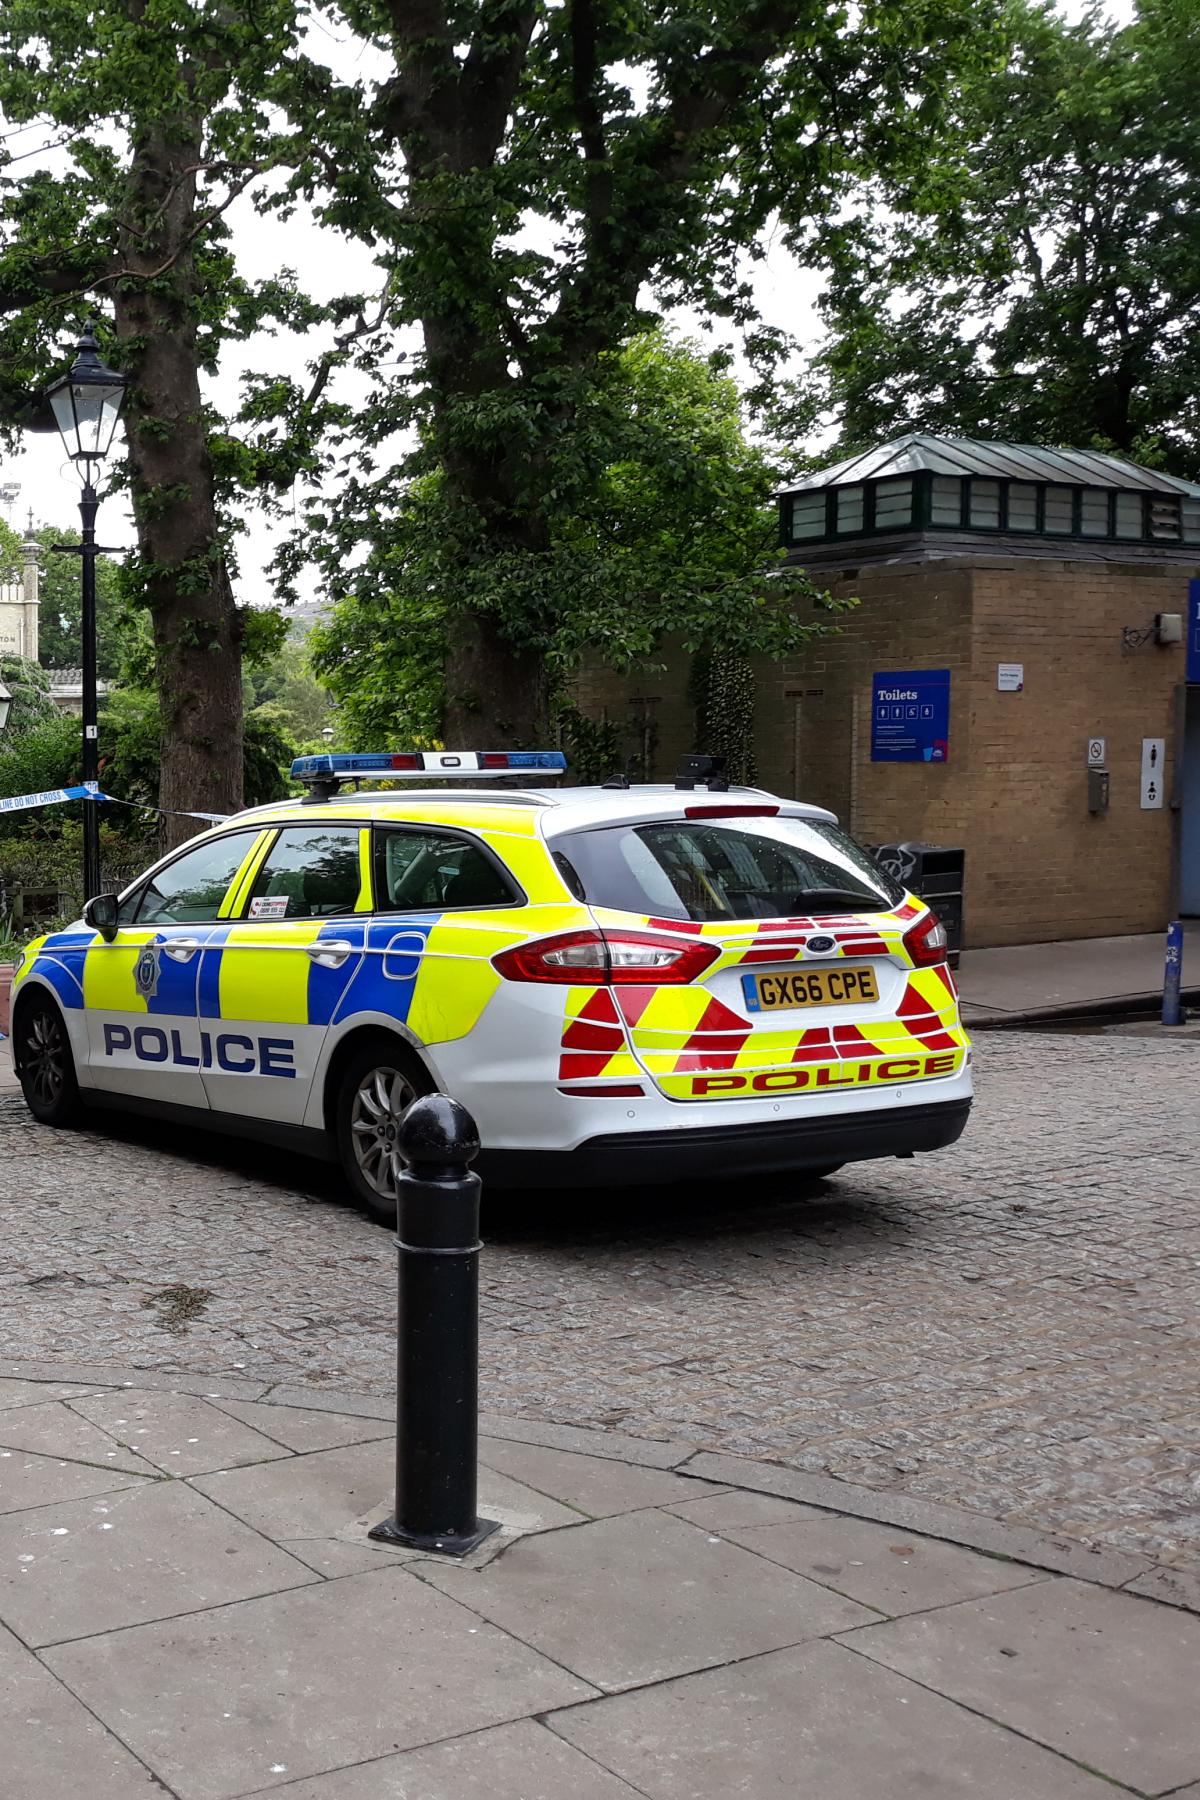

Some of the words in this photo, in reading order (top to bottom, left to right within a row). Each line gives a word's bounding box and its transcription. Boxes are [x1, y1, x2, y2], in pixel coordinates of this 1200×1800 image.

[877, 689, 918, 701] Toilets
[90, 727, 95, 737] 1
[0, 798, 14, 811] LINE
[14, 797, 25, 808] DO
[25, 795, 38, 806] NOT
[39, 791, 62, 804] CROSS
[760, 974, 824, 1006] GX66
[827, 970, 875, 1000] CPE
[103, 1023, 297, 1078] POLICE
[691, 1054, 956, 1095] POLICE
